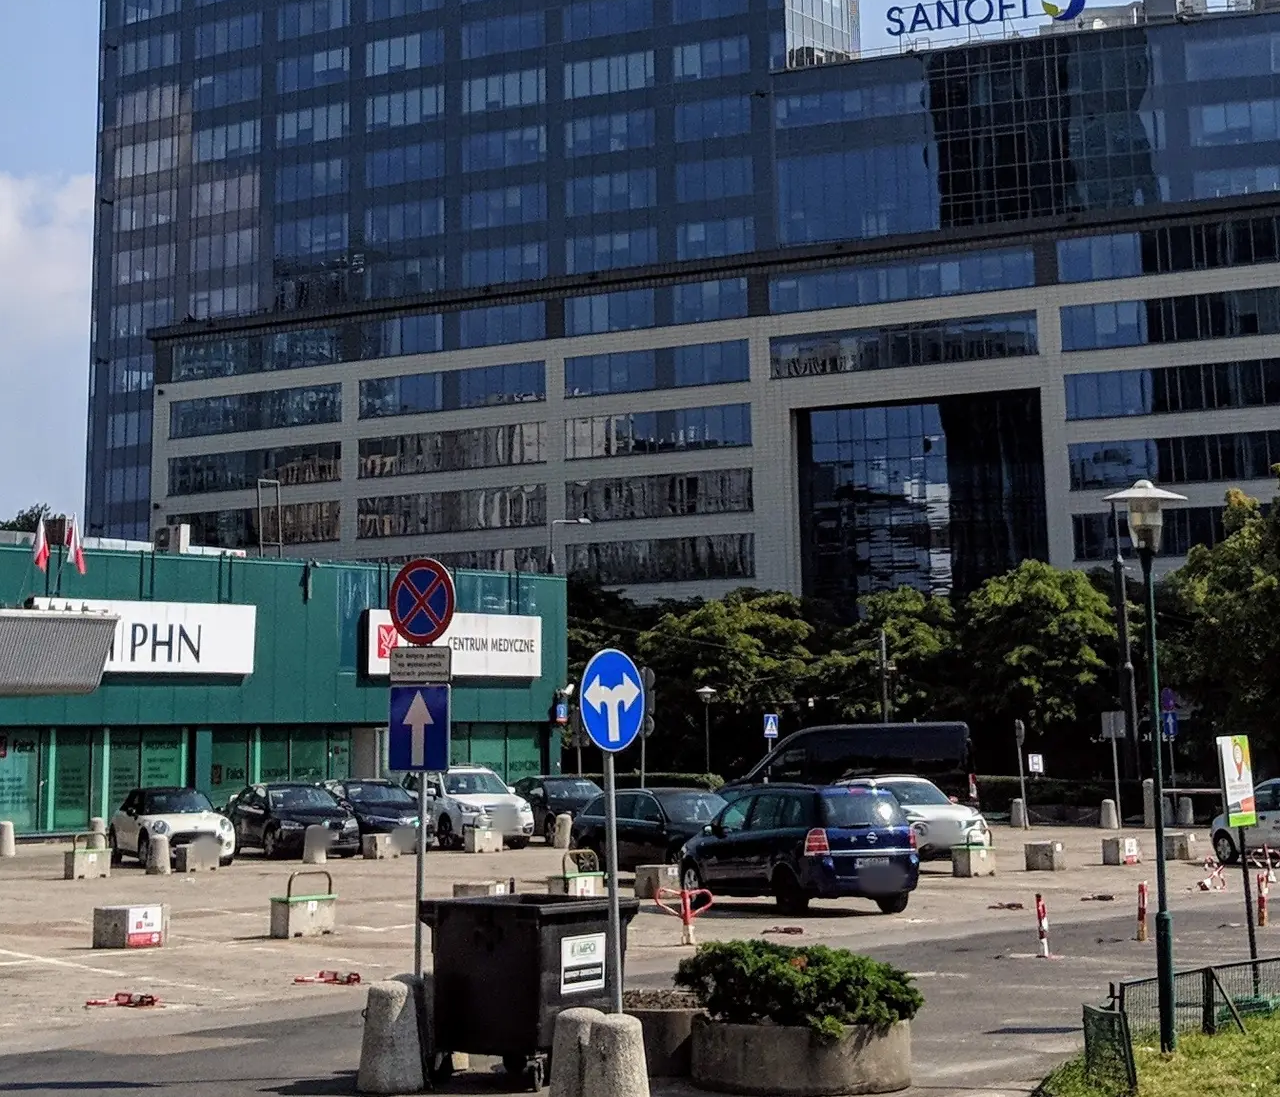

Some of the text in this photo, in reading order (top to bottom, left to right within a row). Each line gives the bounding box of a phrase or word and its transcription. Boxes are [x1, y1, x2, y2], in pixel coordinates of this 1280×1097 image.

[130, 622, 201, 663] PHN
[447, 636, 535, 653] CENTRUM MEDYCZNE
